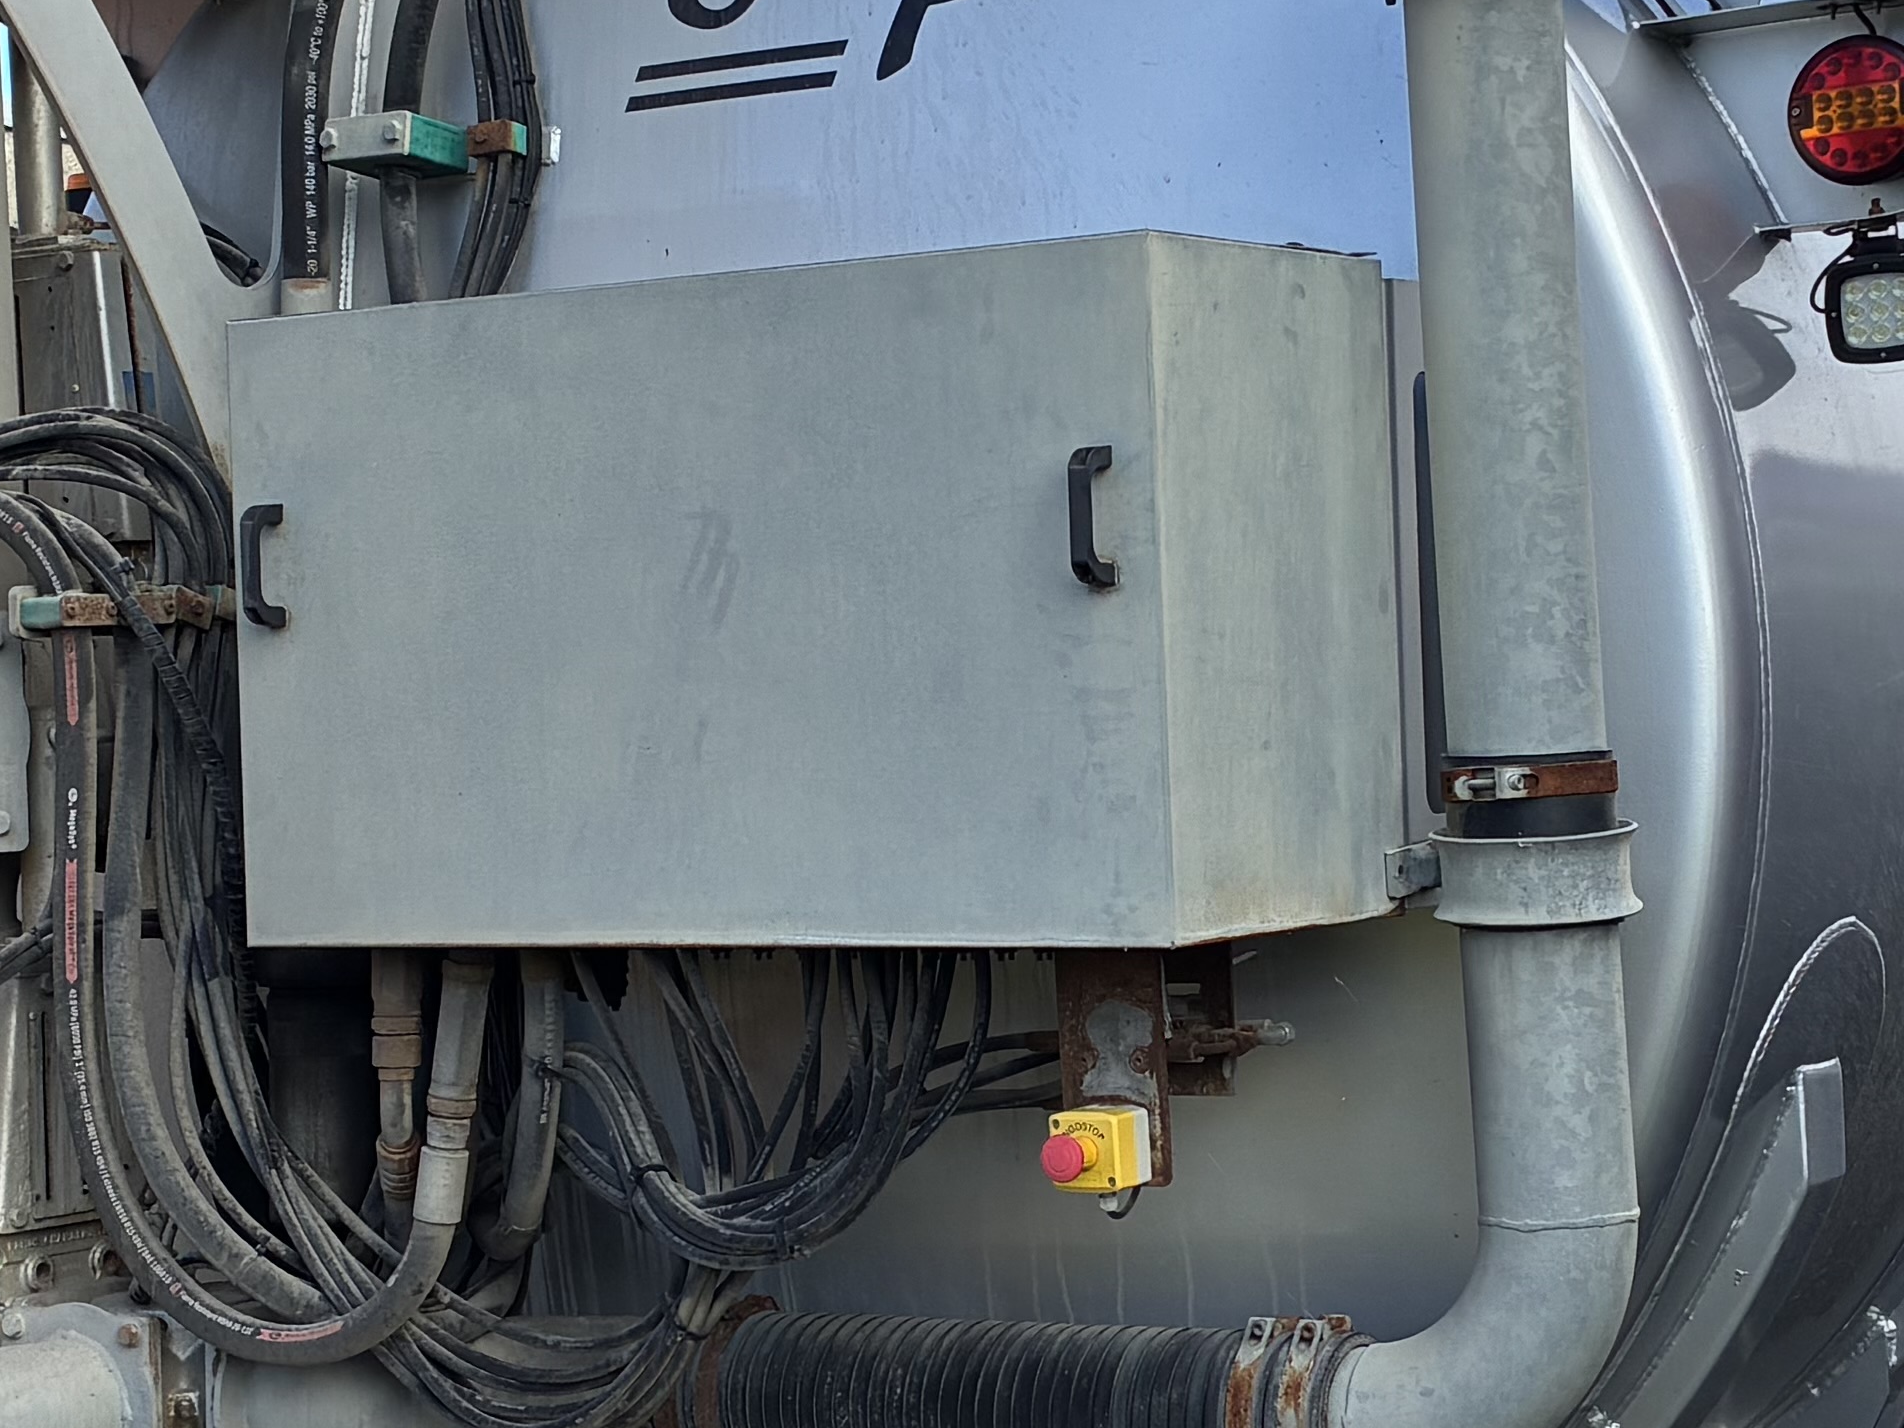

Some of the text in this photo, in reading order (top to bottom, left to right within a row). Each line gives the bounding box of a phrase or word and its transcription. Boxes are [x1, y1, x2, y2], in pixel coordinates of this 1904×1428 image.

[304, 84, 317, 110] 2030
[303, 113, 316, 135] MPa
[303, 160, 316, 177] bar
[303, 177, 316, 195] 140
[304, 200, 317, 218] WP
